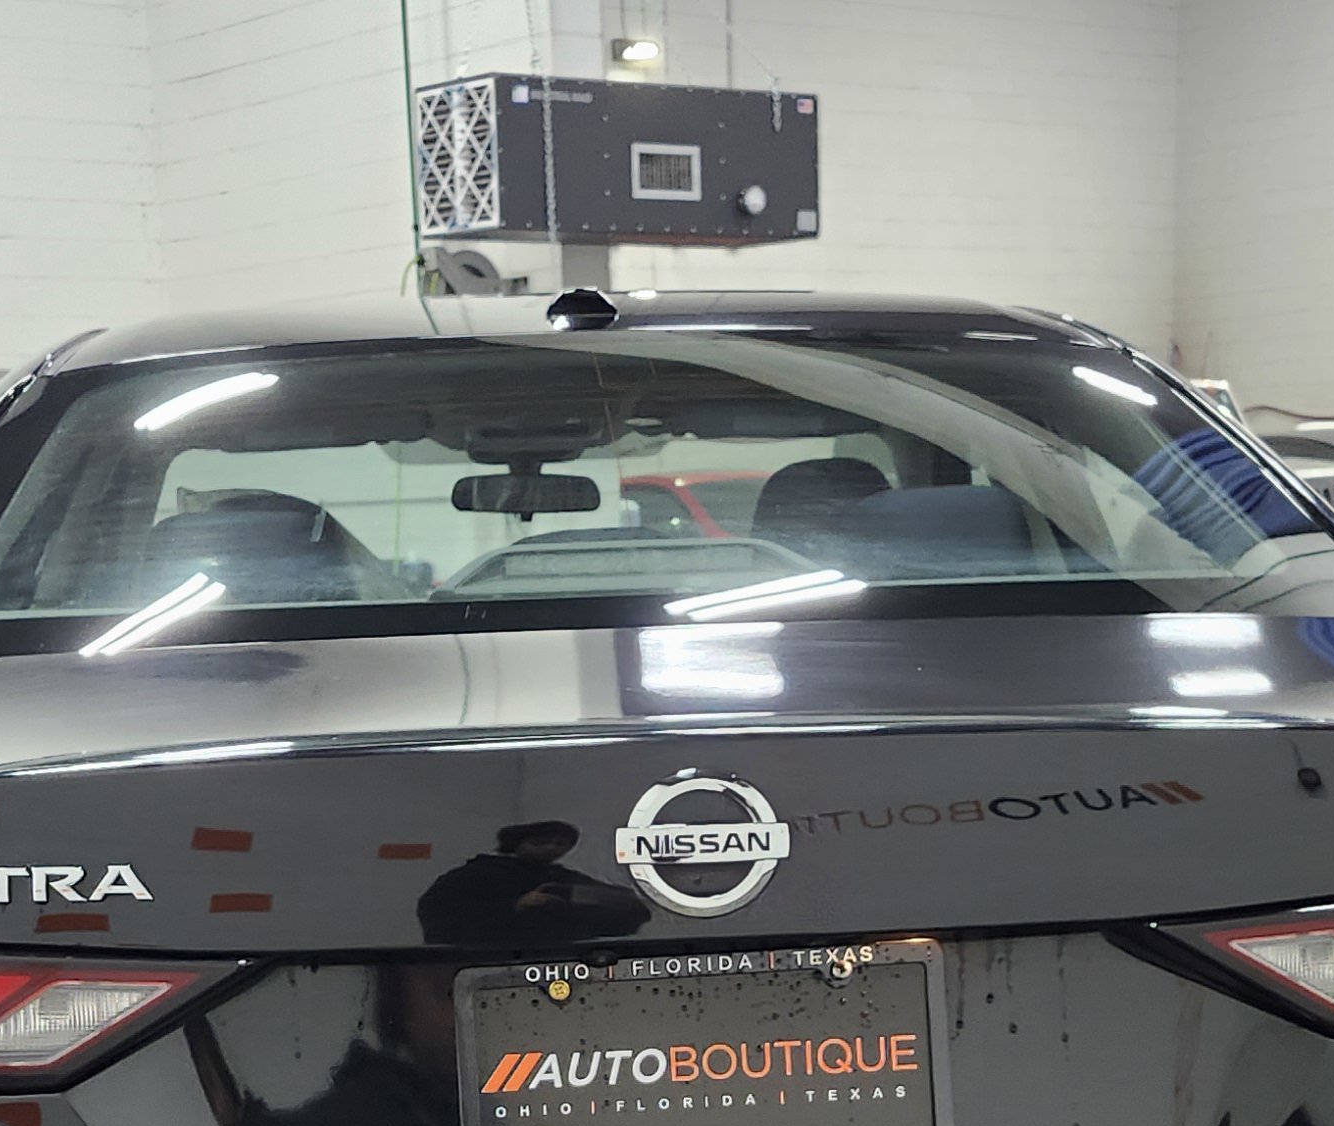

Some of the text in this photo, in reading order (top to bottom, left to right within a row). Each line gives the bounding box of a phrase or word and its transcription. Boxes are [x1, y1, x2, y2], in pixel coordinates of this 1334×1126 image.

[636, 831, 771, 856] NISSAN
[524, 945, 875, 983] OHIO FLORIDA TEXAS
[528, 1033, 919, 1091] AUTOBOUTIQUE
[495, 1084, 907, 1119] OHIO FLORIDA TEXAS
